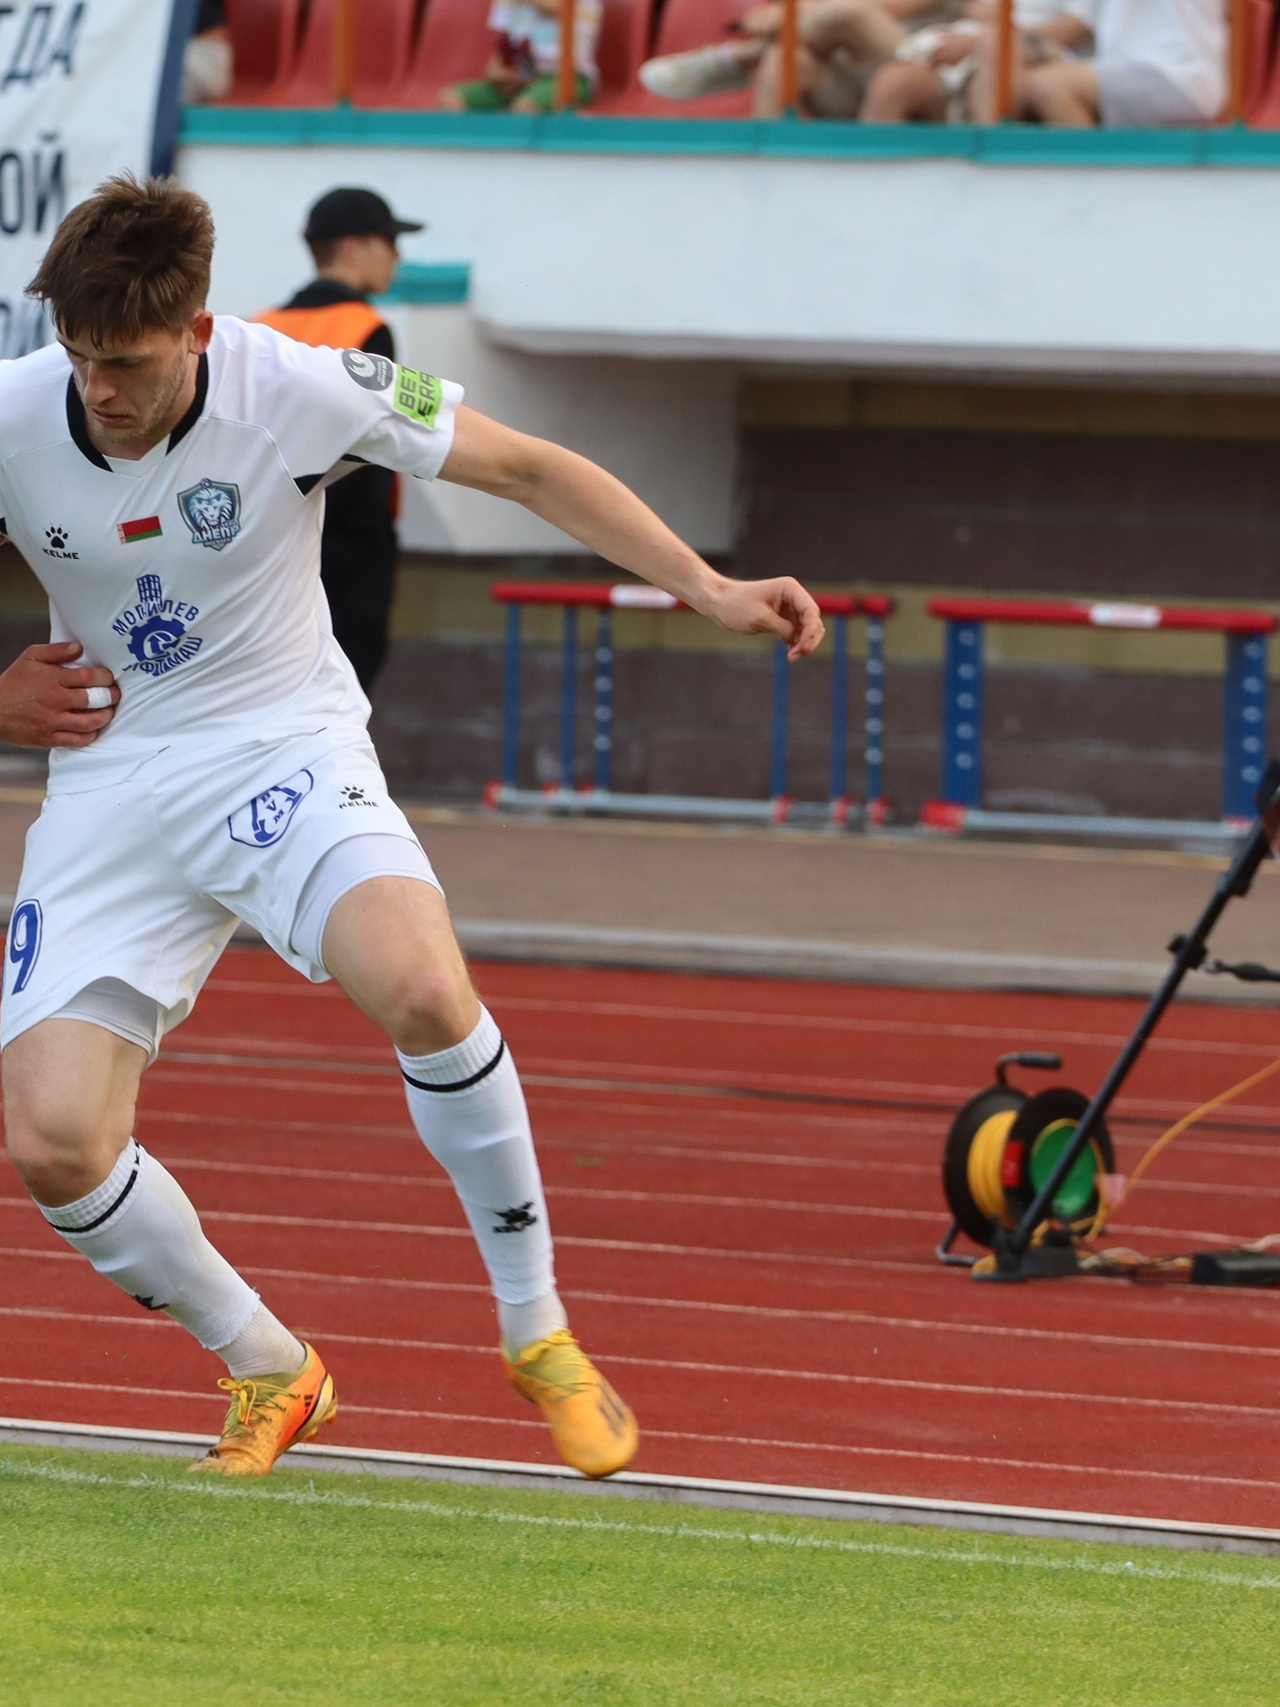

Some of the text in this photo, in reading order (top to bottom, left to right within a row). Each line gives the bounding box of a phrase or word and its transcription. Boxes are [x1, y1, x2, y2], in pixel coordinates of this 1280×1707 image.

[41, 547, 80, 560] KELME
[339, 800, 380, 810] KELME
[9, 898, 43, 996] 9
